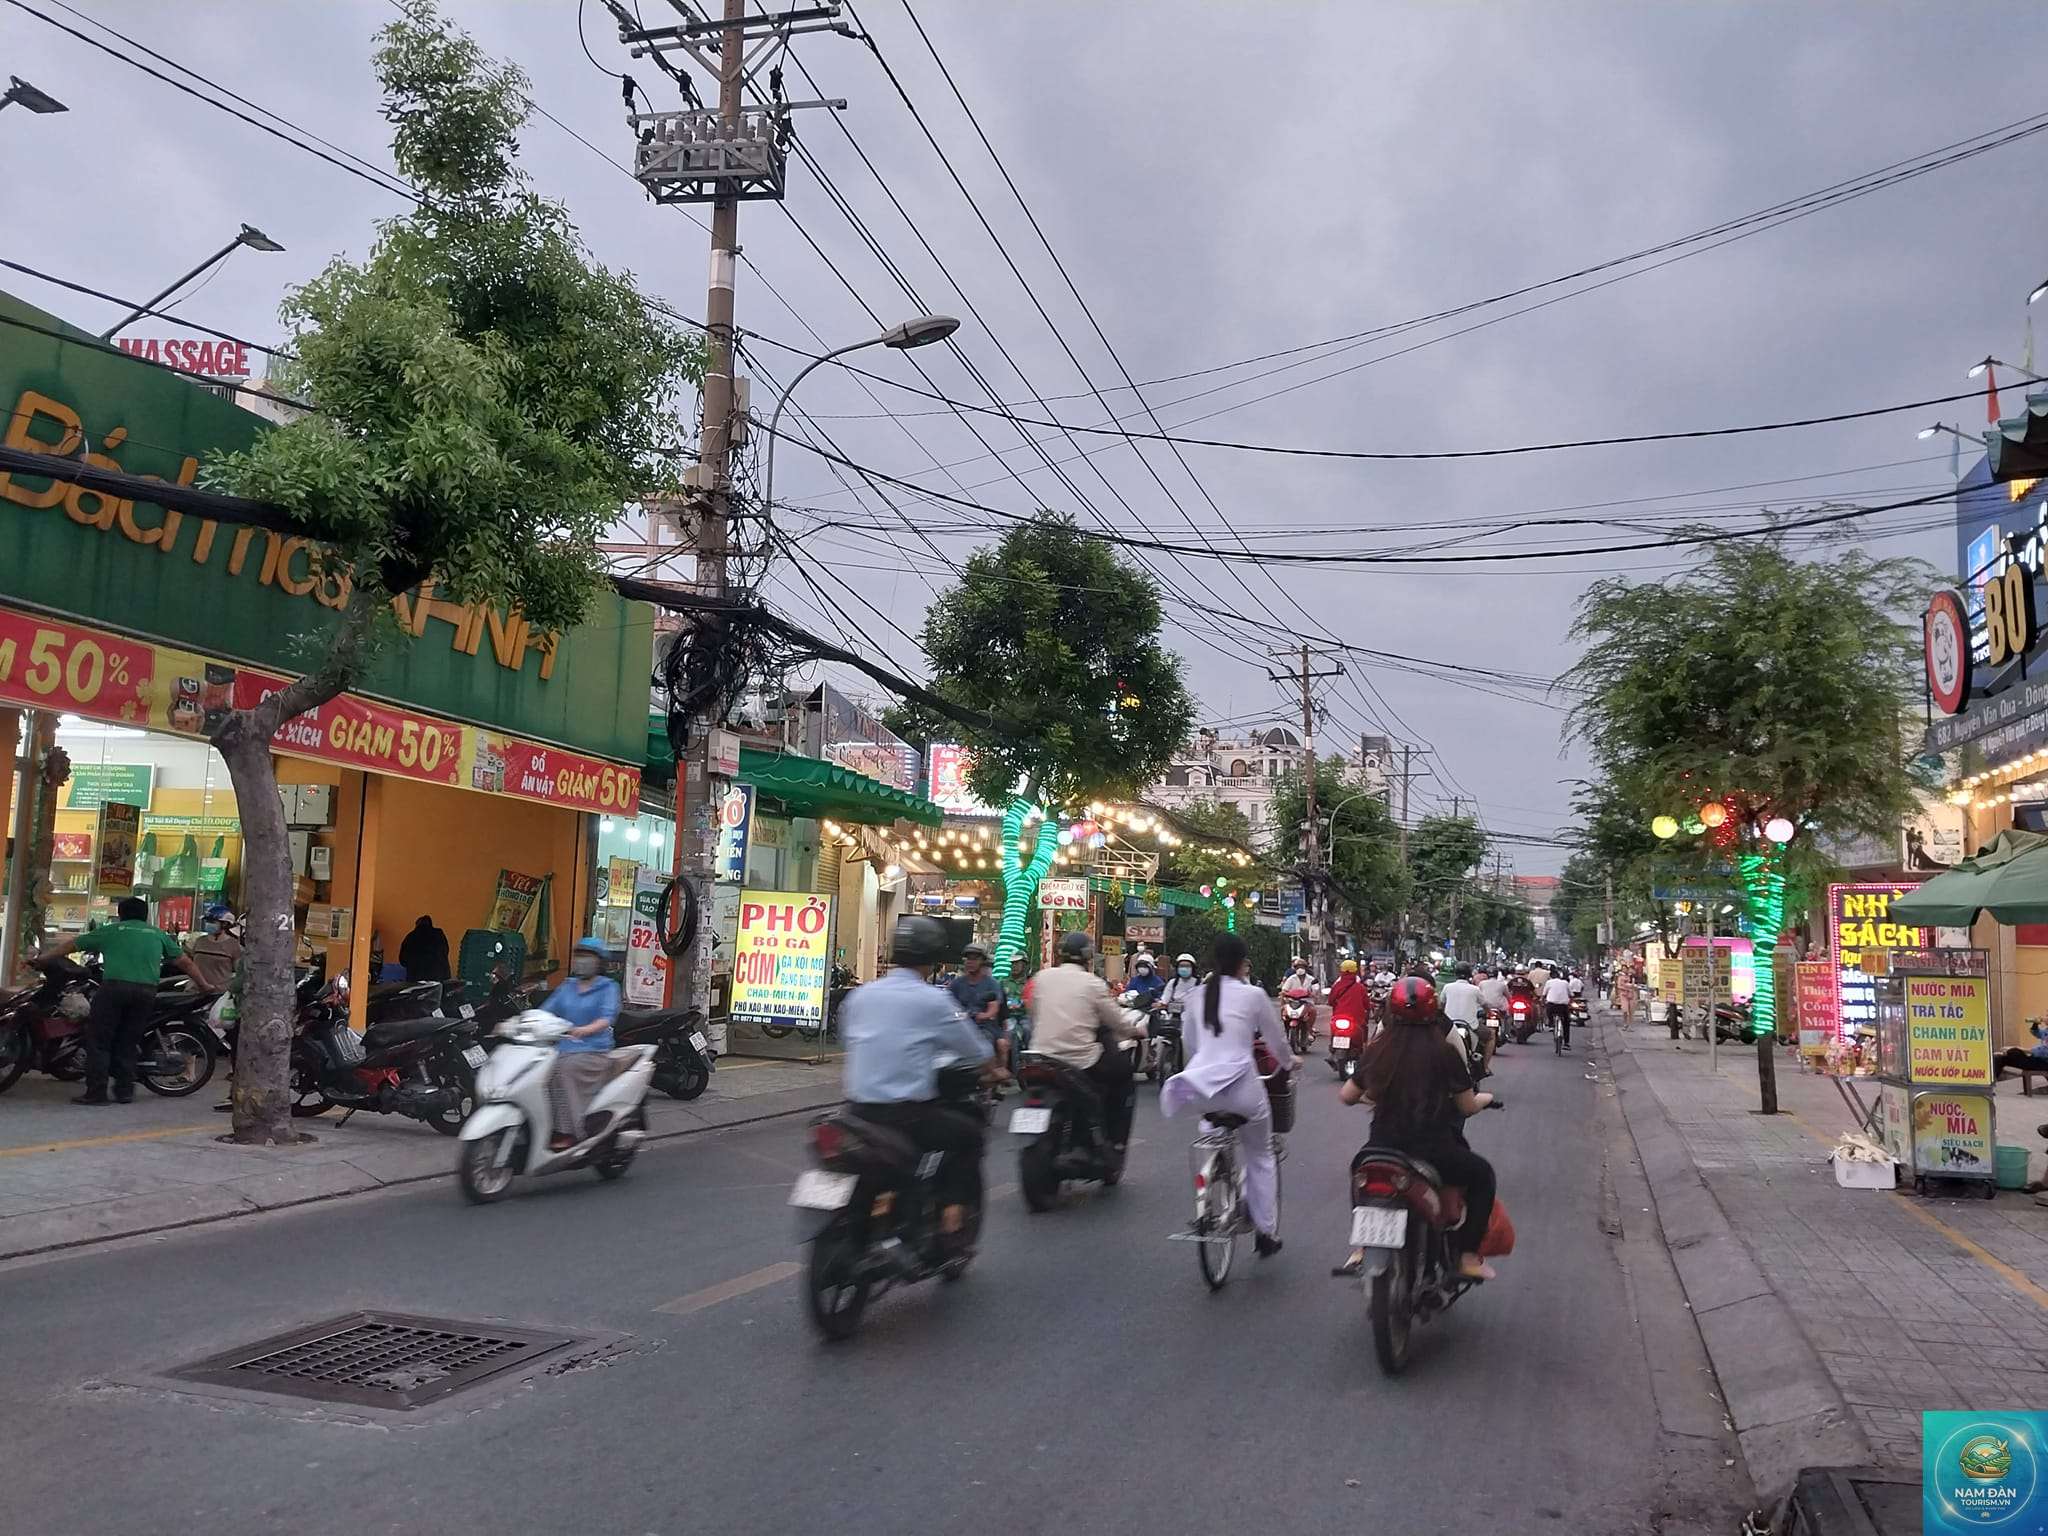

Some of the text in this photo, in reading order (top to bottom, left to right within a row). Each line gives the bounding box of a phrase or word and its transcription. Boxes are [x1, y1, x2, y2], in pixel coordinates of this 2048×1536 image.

[119, 338, 250, 375] MASSAGE
[25, 629, 129, 702] 50%
[286, 720, 323, 748] XÍCH
[329, 711, 455, 772] GIẢM 50%
[531, 751, 548, 773] ĐỒ
[521, 771, 555, 799] ĂN VẬT
[600, 768, 640, 809] 50%
[741, 896, 827, 934] PHỞ
[1844, 890, 1904, 918] NH
[278, 913, 295, 931] 21
[1127, 925, 1164, 937] GYM
[1840, 918, 1921, 946] SÁCH
[735, 950, 775, 985] CƠM
[1911, 981, 1976, 997] NƯỚC MÍA
[1912, 1001, 1964, 1019] TRÀ TẮC
[1913, 1025, 1986, 1041] CHANH DÂY
[1914, 1048, 1941, 1062] CAM
[1914, 1065, 1986, 1081] NƯỚC ƯỚP LẠNH
[1930, 1101, 1962, 1117] NƯỚC
[1947, 1111, 1978, 1135] MÍA
[1942, 1137, 1961, 1148] SIÊU
